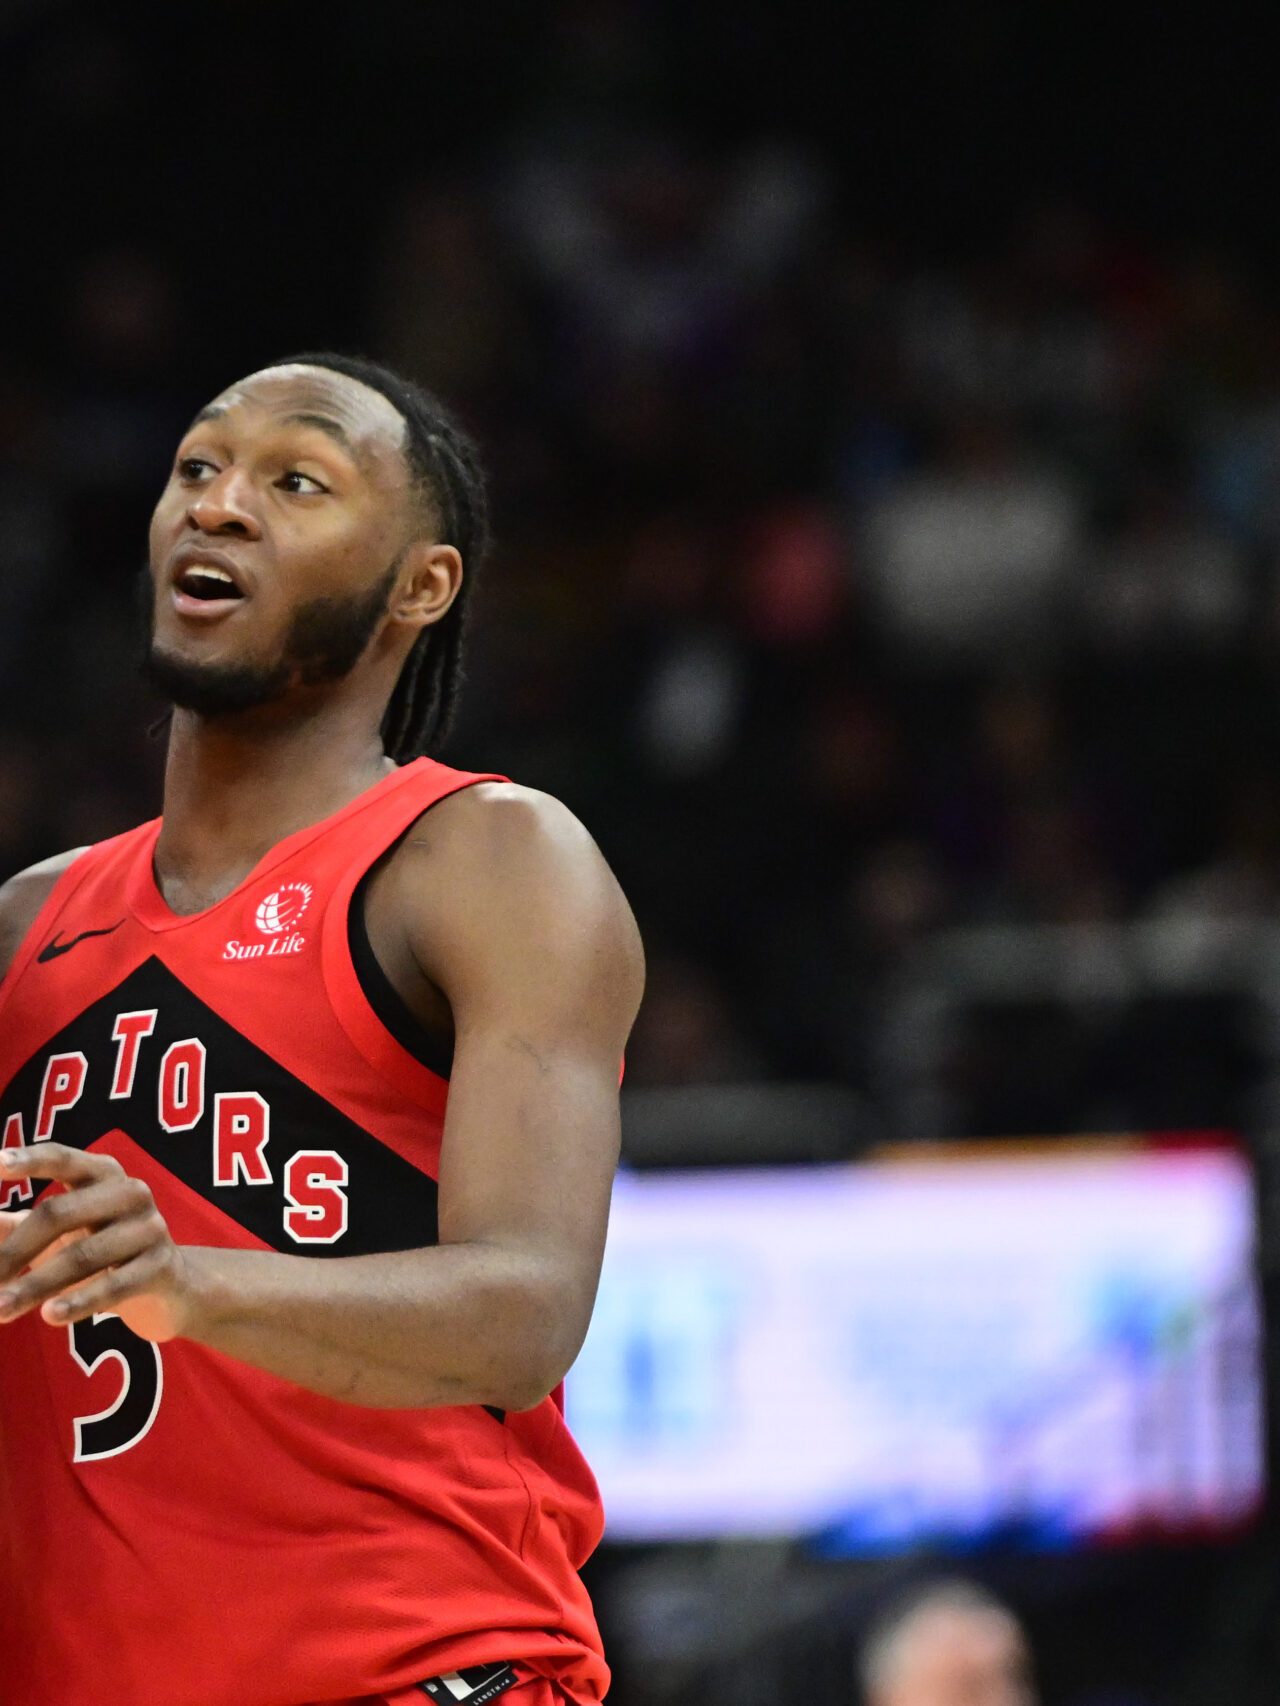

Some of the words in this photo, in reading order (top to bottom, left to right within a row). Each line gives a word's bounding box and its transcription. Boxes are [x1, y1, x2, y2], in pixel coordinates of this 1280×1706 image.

[223, 940, 265, 960] Sun
[267, 932, 305, 955] Life
[68, 1311, 163, 1463] 5
